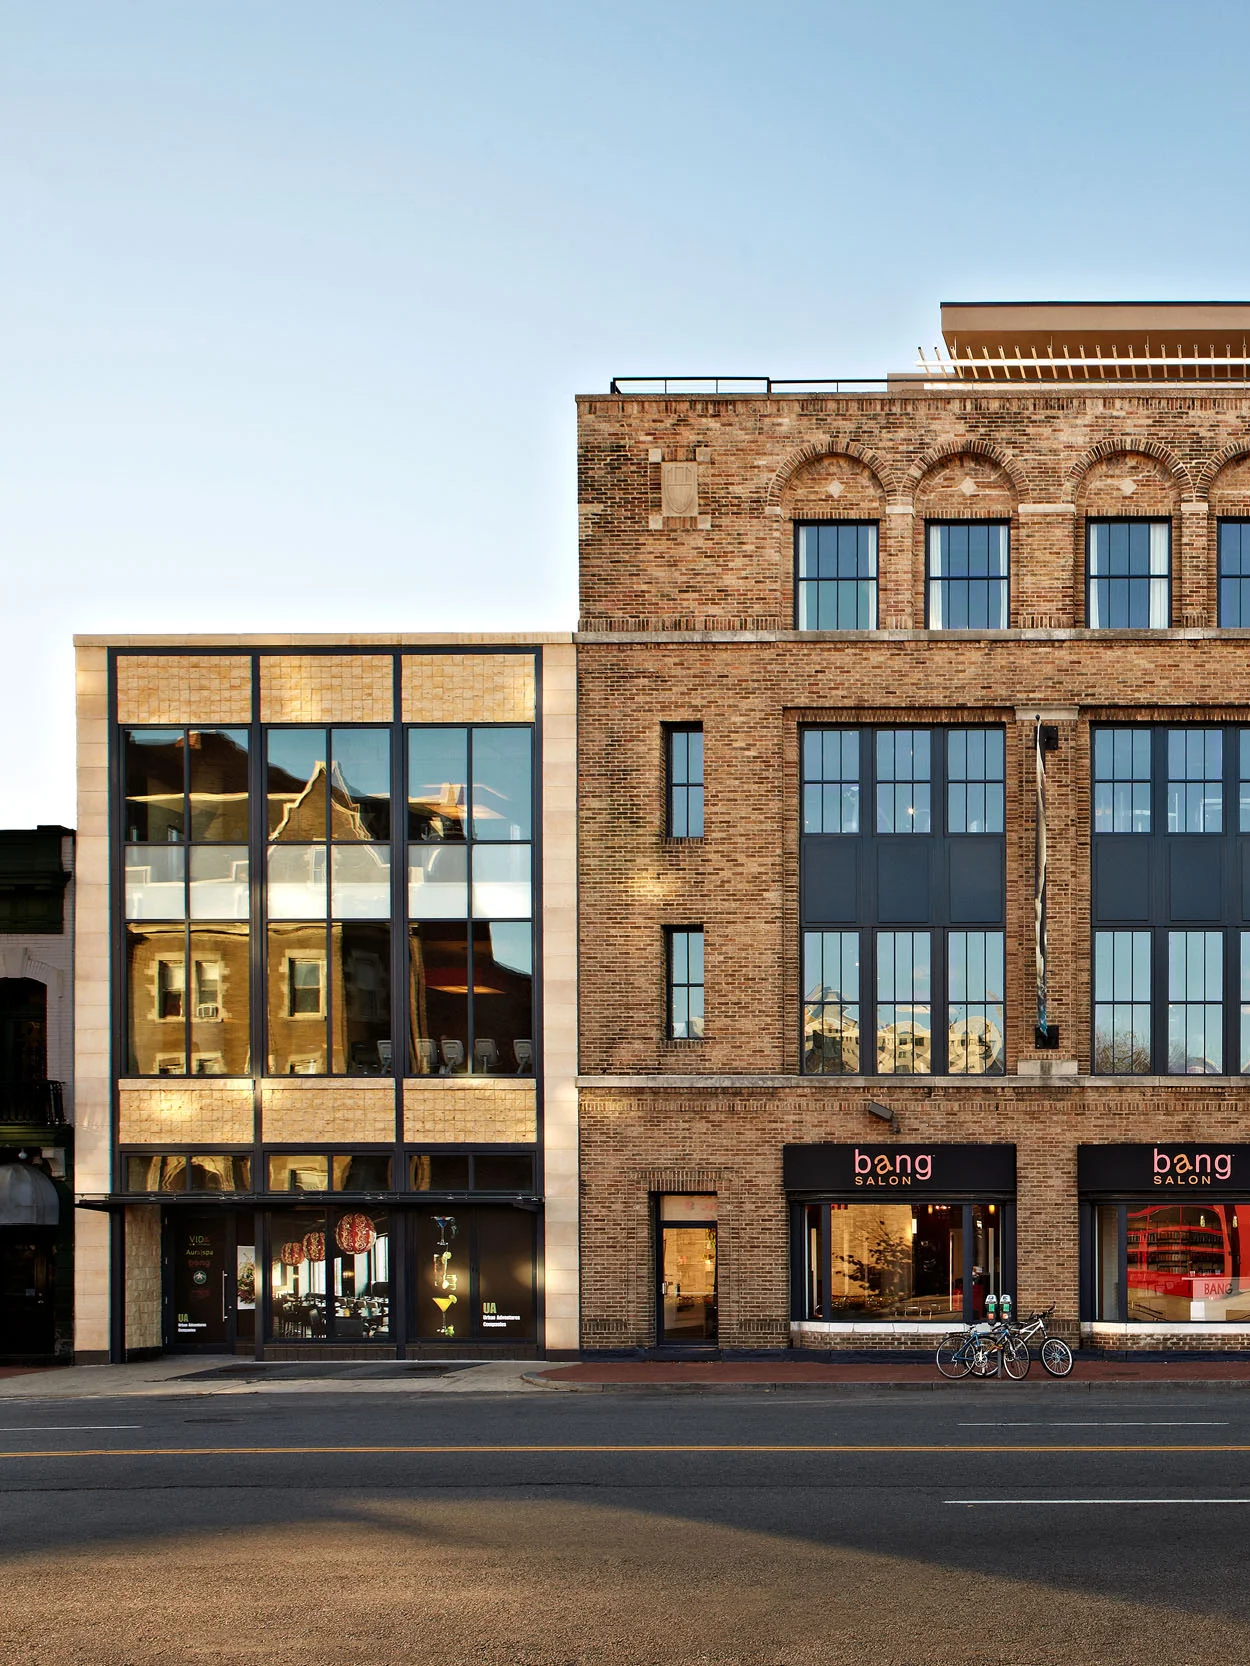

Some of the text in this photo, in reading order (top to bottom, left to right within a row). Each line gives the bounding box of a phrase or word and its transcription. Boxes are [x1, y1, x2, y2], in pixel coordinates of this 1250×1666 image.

[854, 1148, 932, 1180] bang
[1153, 1147, 1232, 1180] bang
[854, 1176, 911, 1186] SALON
[1153, 1175, 1212, 1185] SALON
[1204, 1282, 1233, 1295] BANG
[483, 1302, 497, 1314] UA
